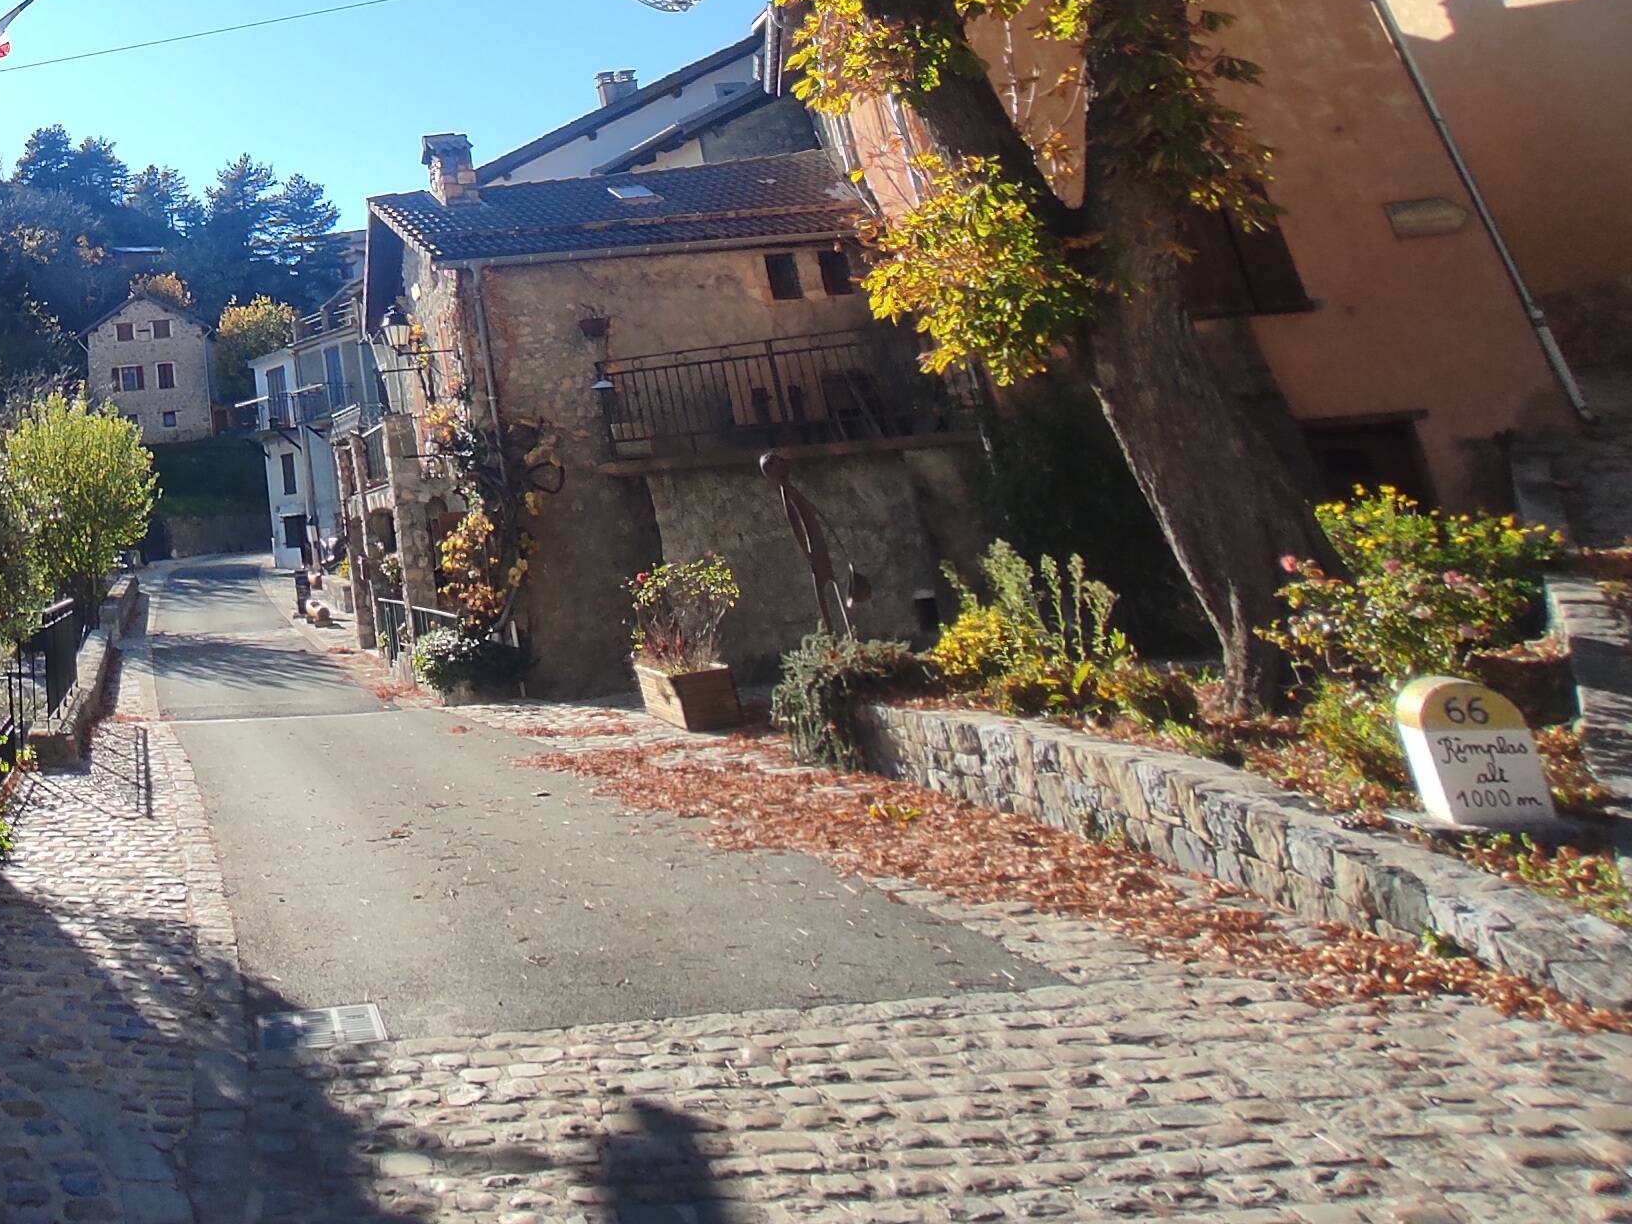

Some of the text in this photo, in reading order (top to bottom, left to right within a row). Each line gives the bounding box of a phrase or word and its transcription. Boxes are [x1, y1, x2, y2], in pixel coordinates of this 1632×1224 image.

[1444, 696, 1489, 725] 66
[1437, 736, 1528, 764] Rimplas
[1456, 788, 1512, 808] 1000
